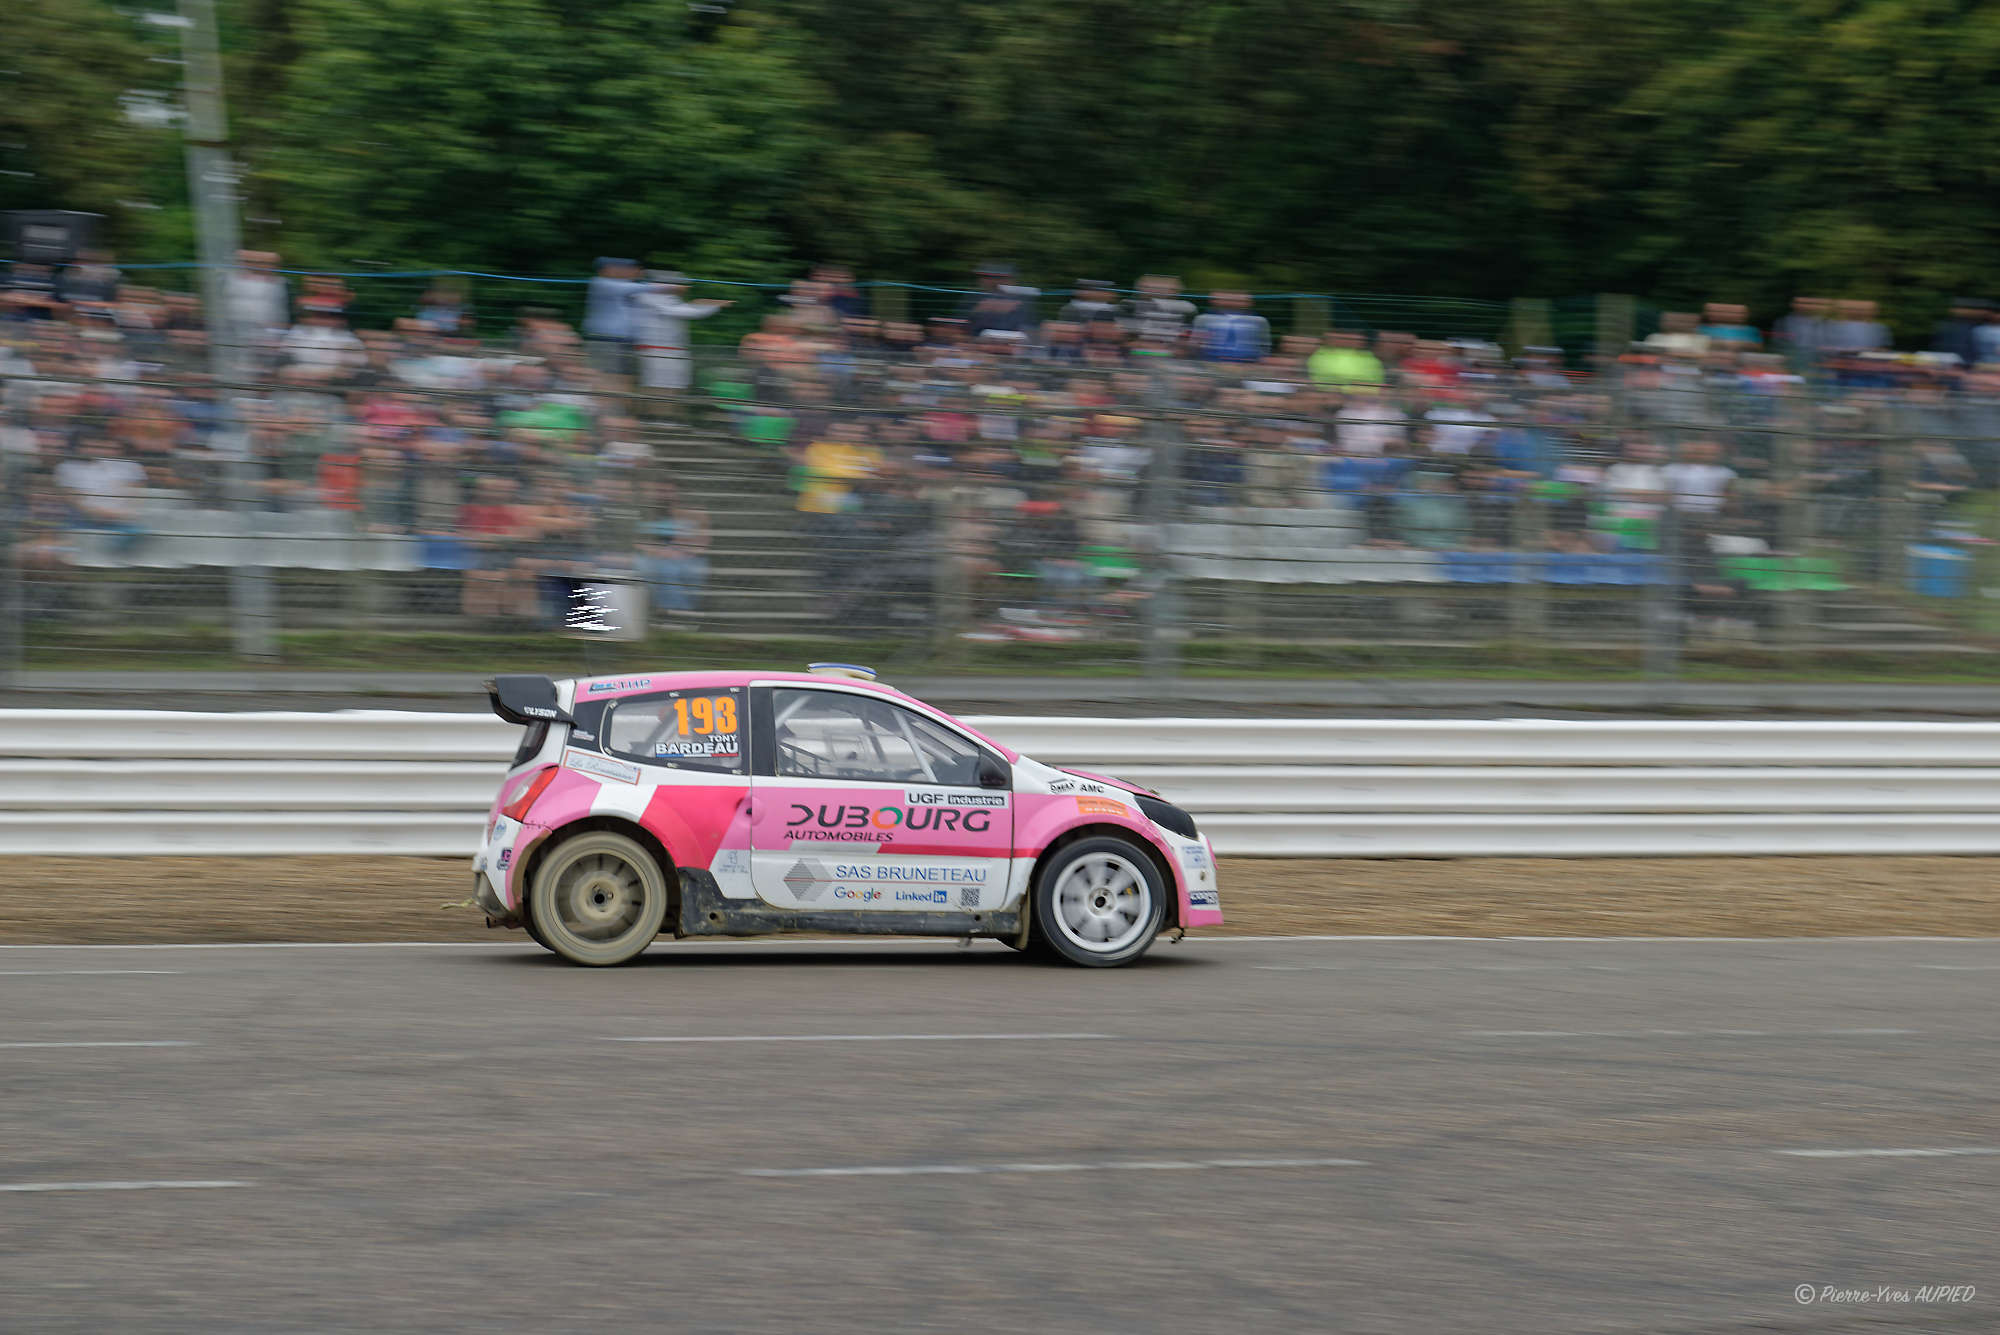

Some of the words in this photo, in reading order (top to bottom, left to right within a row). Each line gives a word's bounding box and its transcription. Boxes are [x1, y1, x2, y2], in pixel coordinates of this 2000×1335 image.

[673, 696, 738, 735] 193
[707, 734, 738, 743] TONY
[656, 742, 739, 754] BARDEAU
[908, 793, 944, 804] UGF
[786, 804, 992, 832] DUBOURG
[783, 830, 894, 842] AUTOMOBILES
[835, 864, 871, 879] SAS
[877, 866, 987, 882] BRUNETEAU
[834, 886, 881, 902] Google
